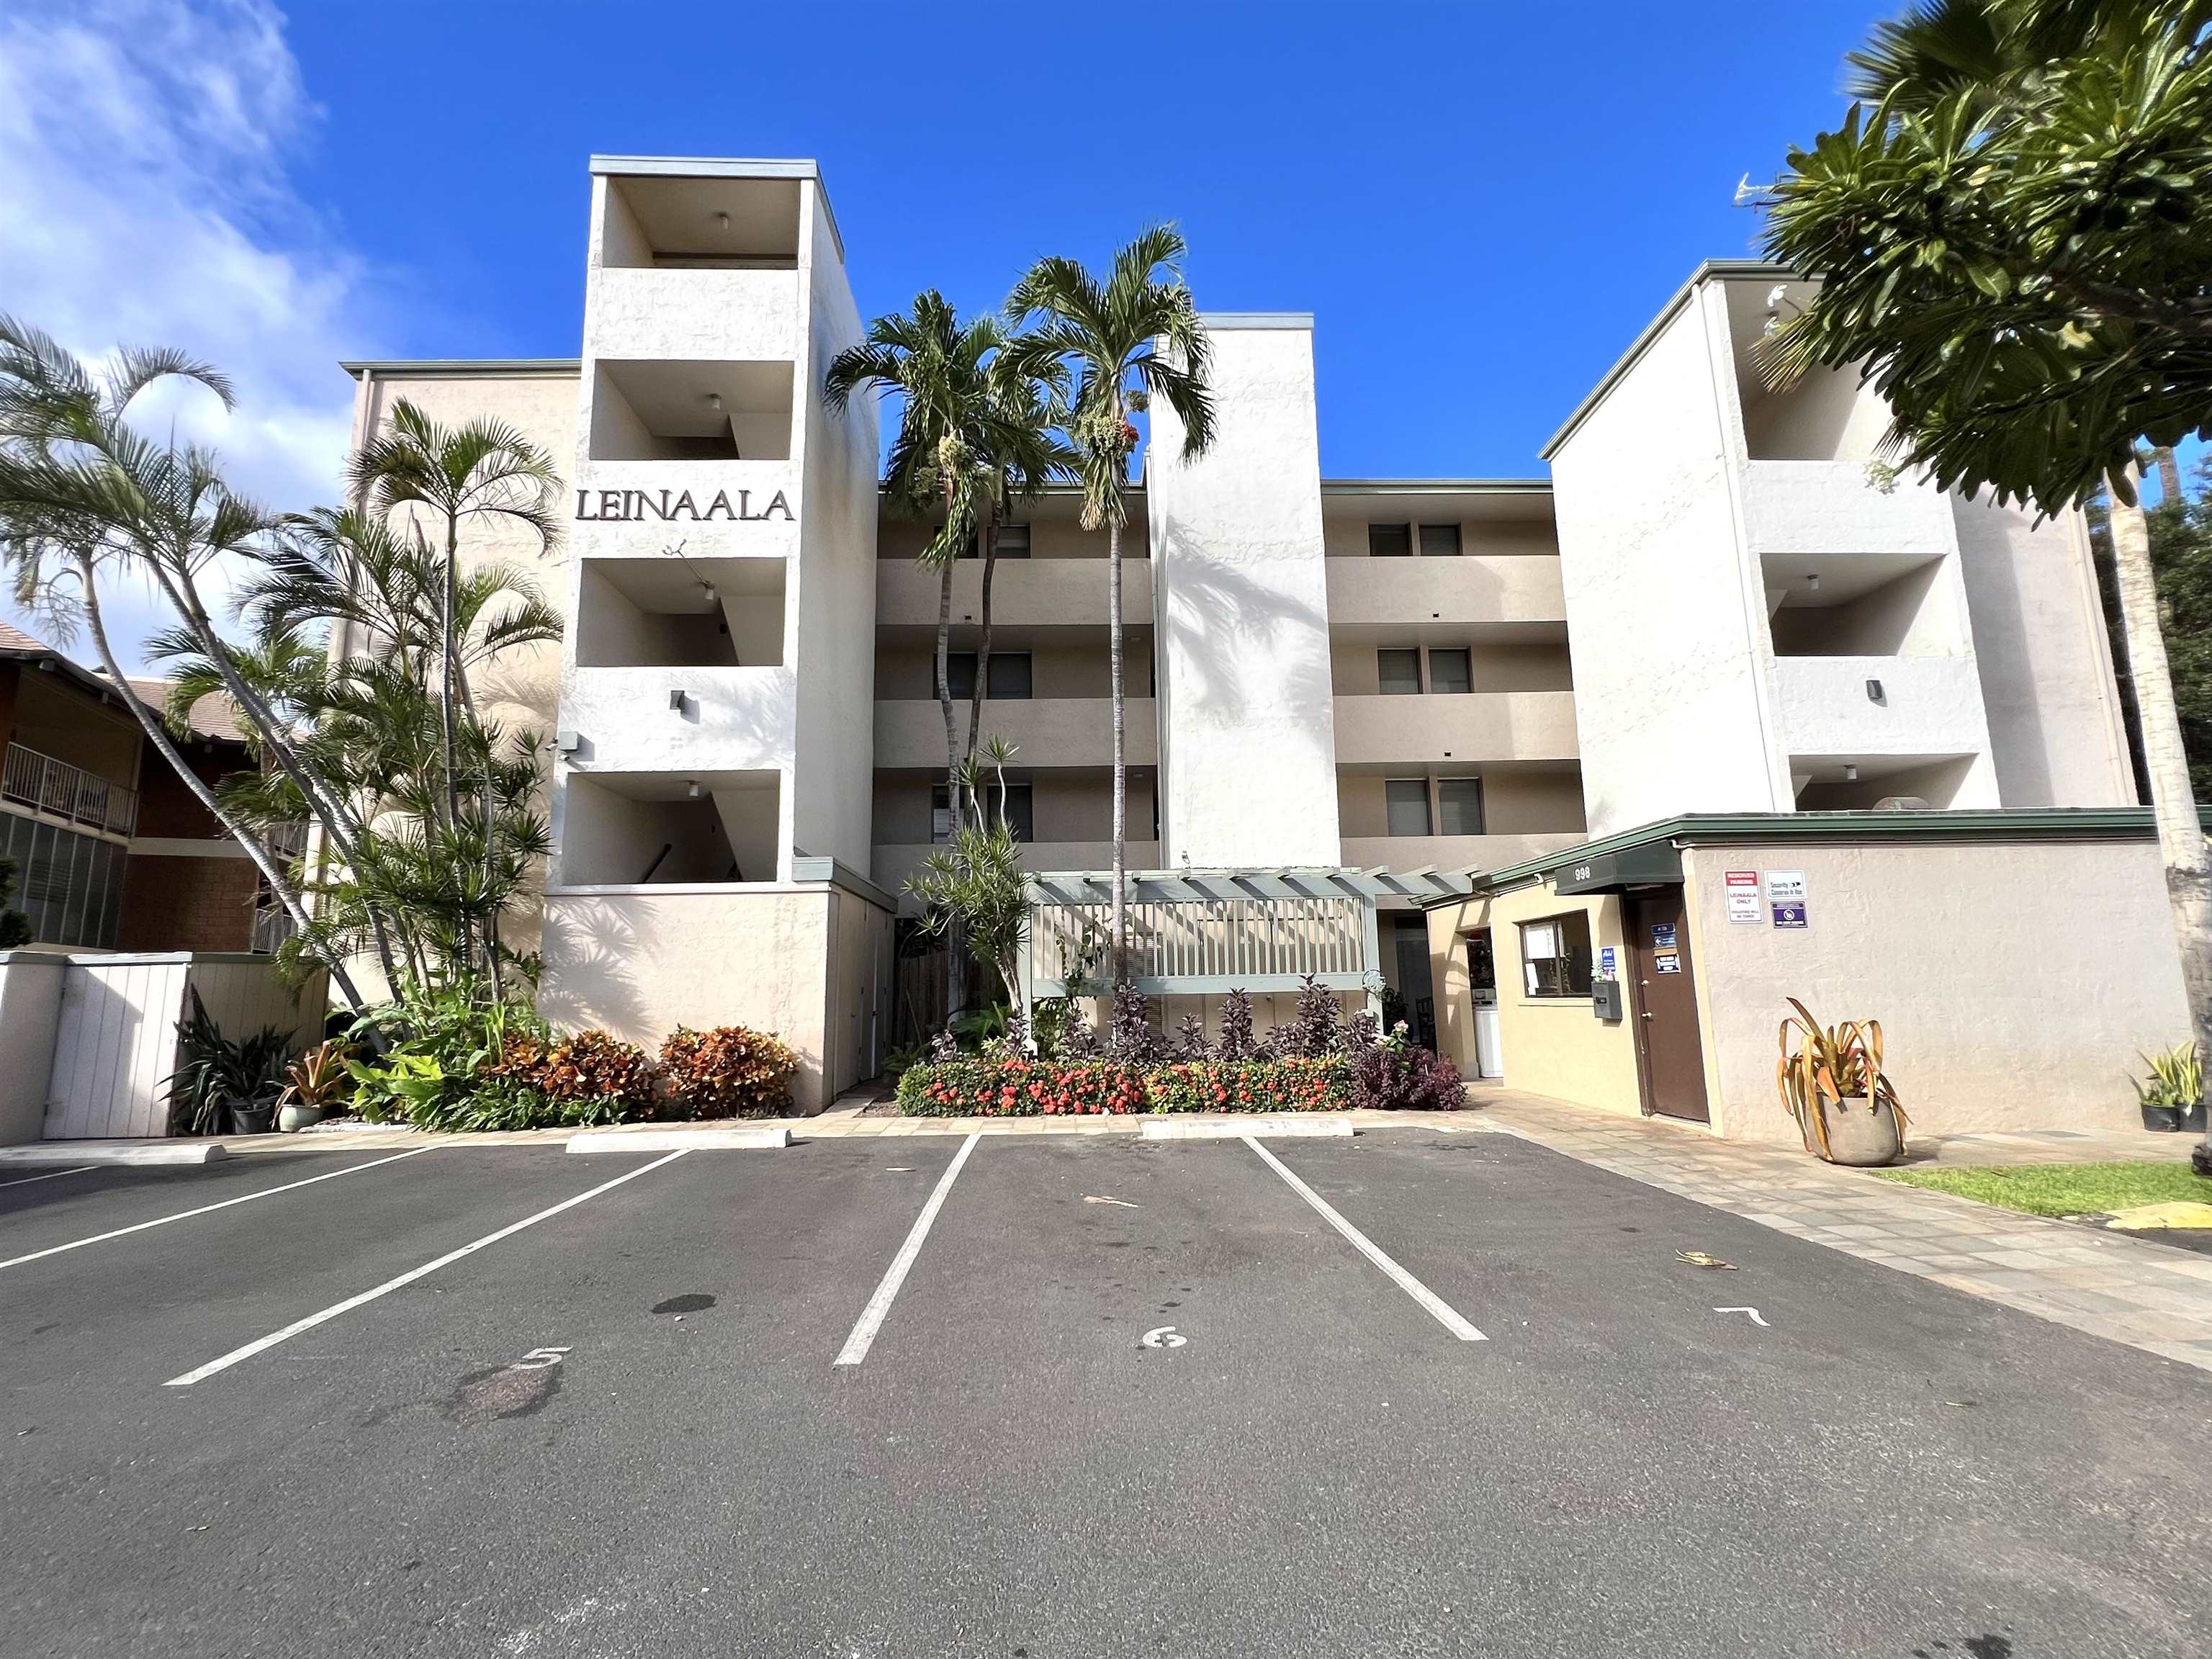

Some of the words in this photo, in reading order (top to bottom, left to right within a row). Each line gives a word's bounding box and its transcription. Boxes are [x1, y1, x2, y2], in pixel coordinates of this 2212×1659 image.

[575, 489, 796, 521] LEINAALA
[1575, 866, 1591, 881] 998
[1142, 1326, 1187, 1348] 6
[509, 1344, 574, 1370] 5
